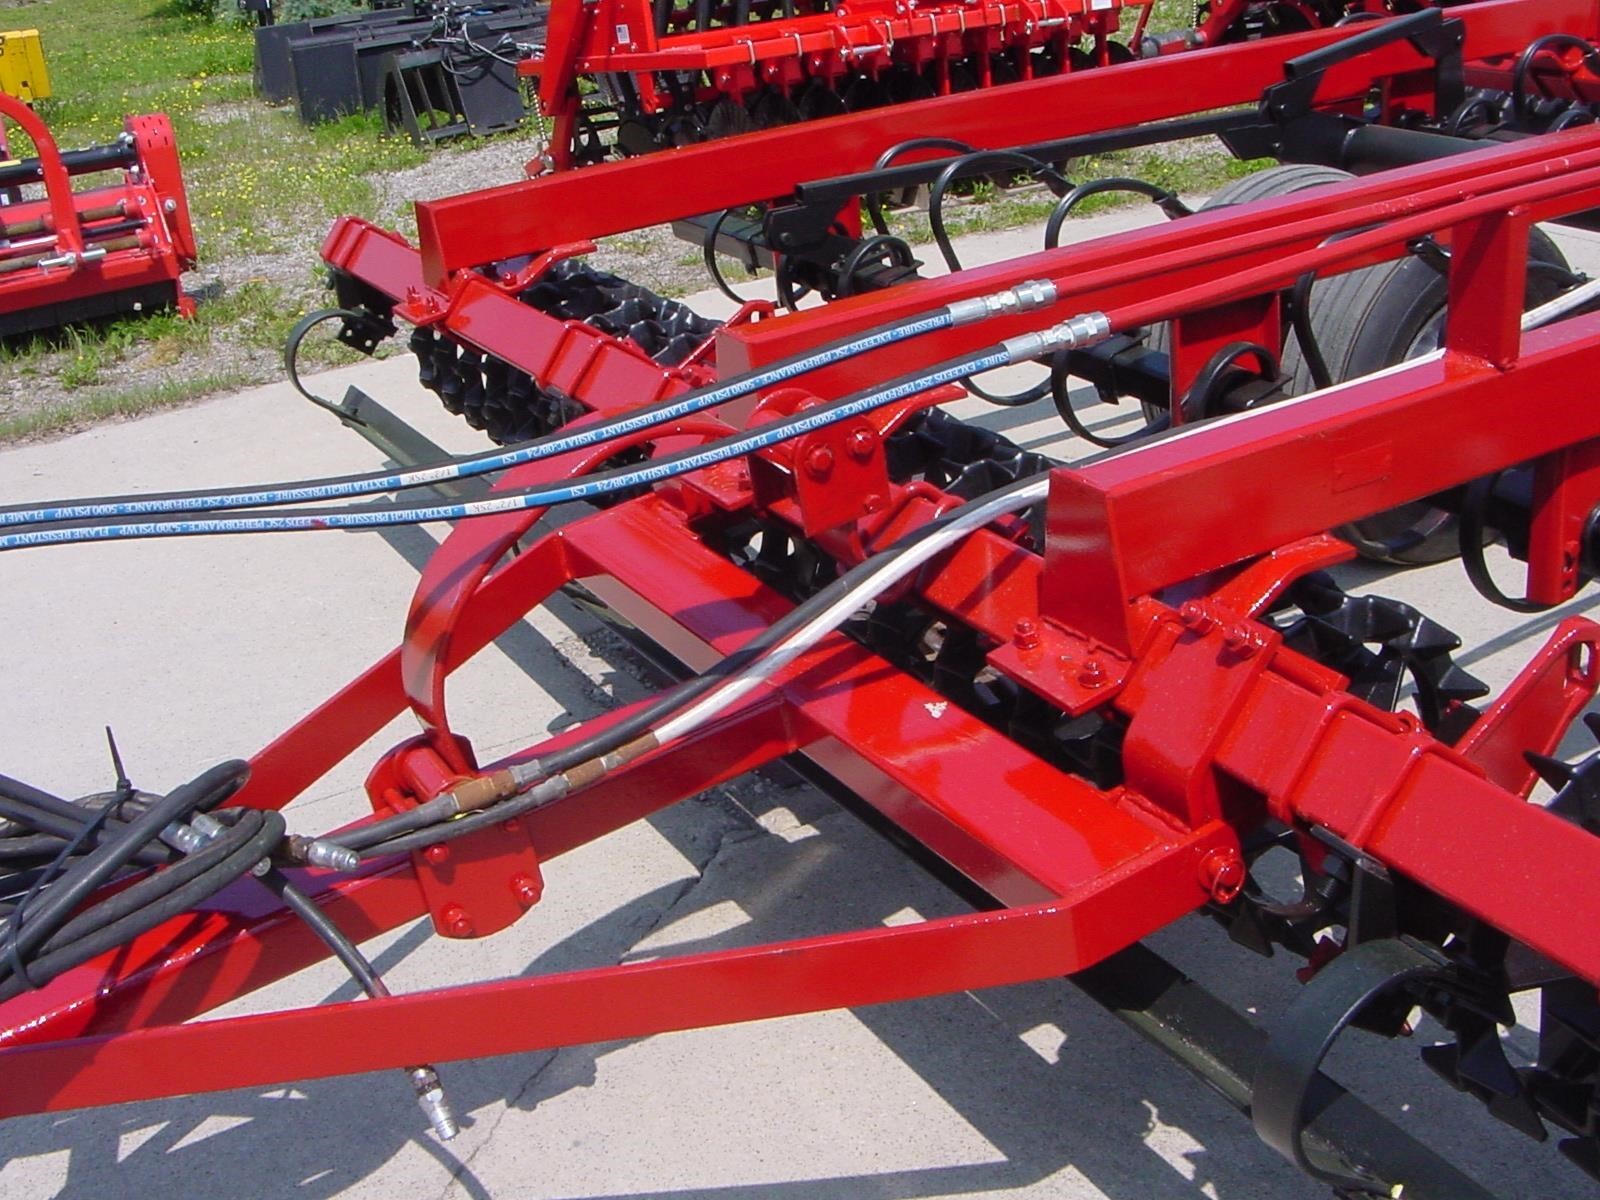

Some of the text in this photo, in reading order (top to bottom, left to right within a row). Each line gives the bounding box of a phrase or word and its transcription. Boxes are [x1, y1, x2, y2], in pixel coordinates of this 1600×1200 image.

[762, 353, 830, 384] PERFORMANCE
[934, 362, 976, 385] EXCEEDS
[732, 380, 756, 398] 5000
[698, 394, 716, 406] WP
[716, 390, 732, 402] PSI
[842, 382, 915, 418] PERFORMANCE
[655, 404, 688, 425] FLAME
[810, 412, 836, 427] 5000
[601, 417, 654, 439] RESISTANT
[795, 419, 810, 431] PSI
[776, 424, 796, 439] WP
[733, 436, 768, 455] FLAME
[502, 454, 516, 465] CSI
[676, 448, 732, 471] RESISTANT
[639, 466, 670, 483] MSHA
[326, 484, 353, 496] HIGH
[354, 480, 388, 492] EXTRA
[570, 486, 586, 497] CSI
[223, 494, 268, 506] EXCEEDS
[276, 487, 326, 501] PRESSURE
[75, 507, 90, 517] PSI
[92, 505, 117, 515] 5000
[126, 500, 202, 512] PERFORMANCE
[8, 511, 44, 524] FLAME
[55, 508, 75, 519] WP
[338, 512, 388, 524] PRESSURE
[390, 510, 416, 521] HIGH
[416, 506, 452, 519] EXTRA
[119, 525, 138, 535] WP
[188, 520, 266, 531] PERFORMANCE
[14, 531, 72, 545] RESISTANT
[72, 528, 110, 539] FLAME
